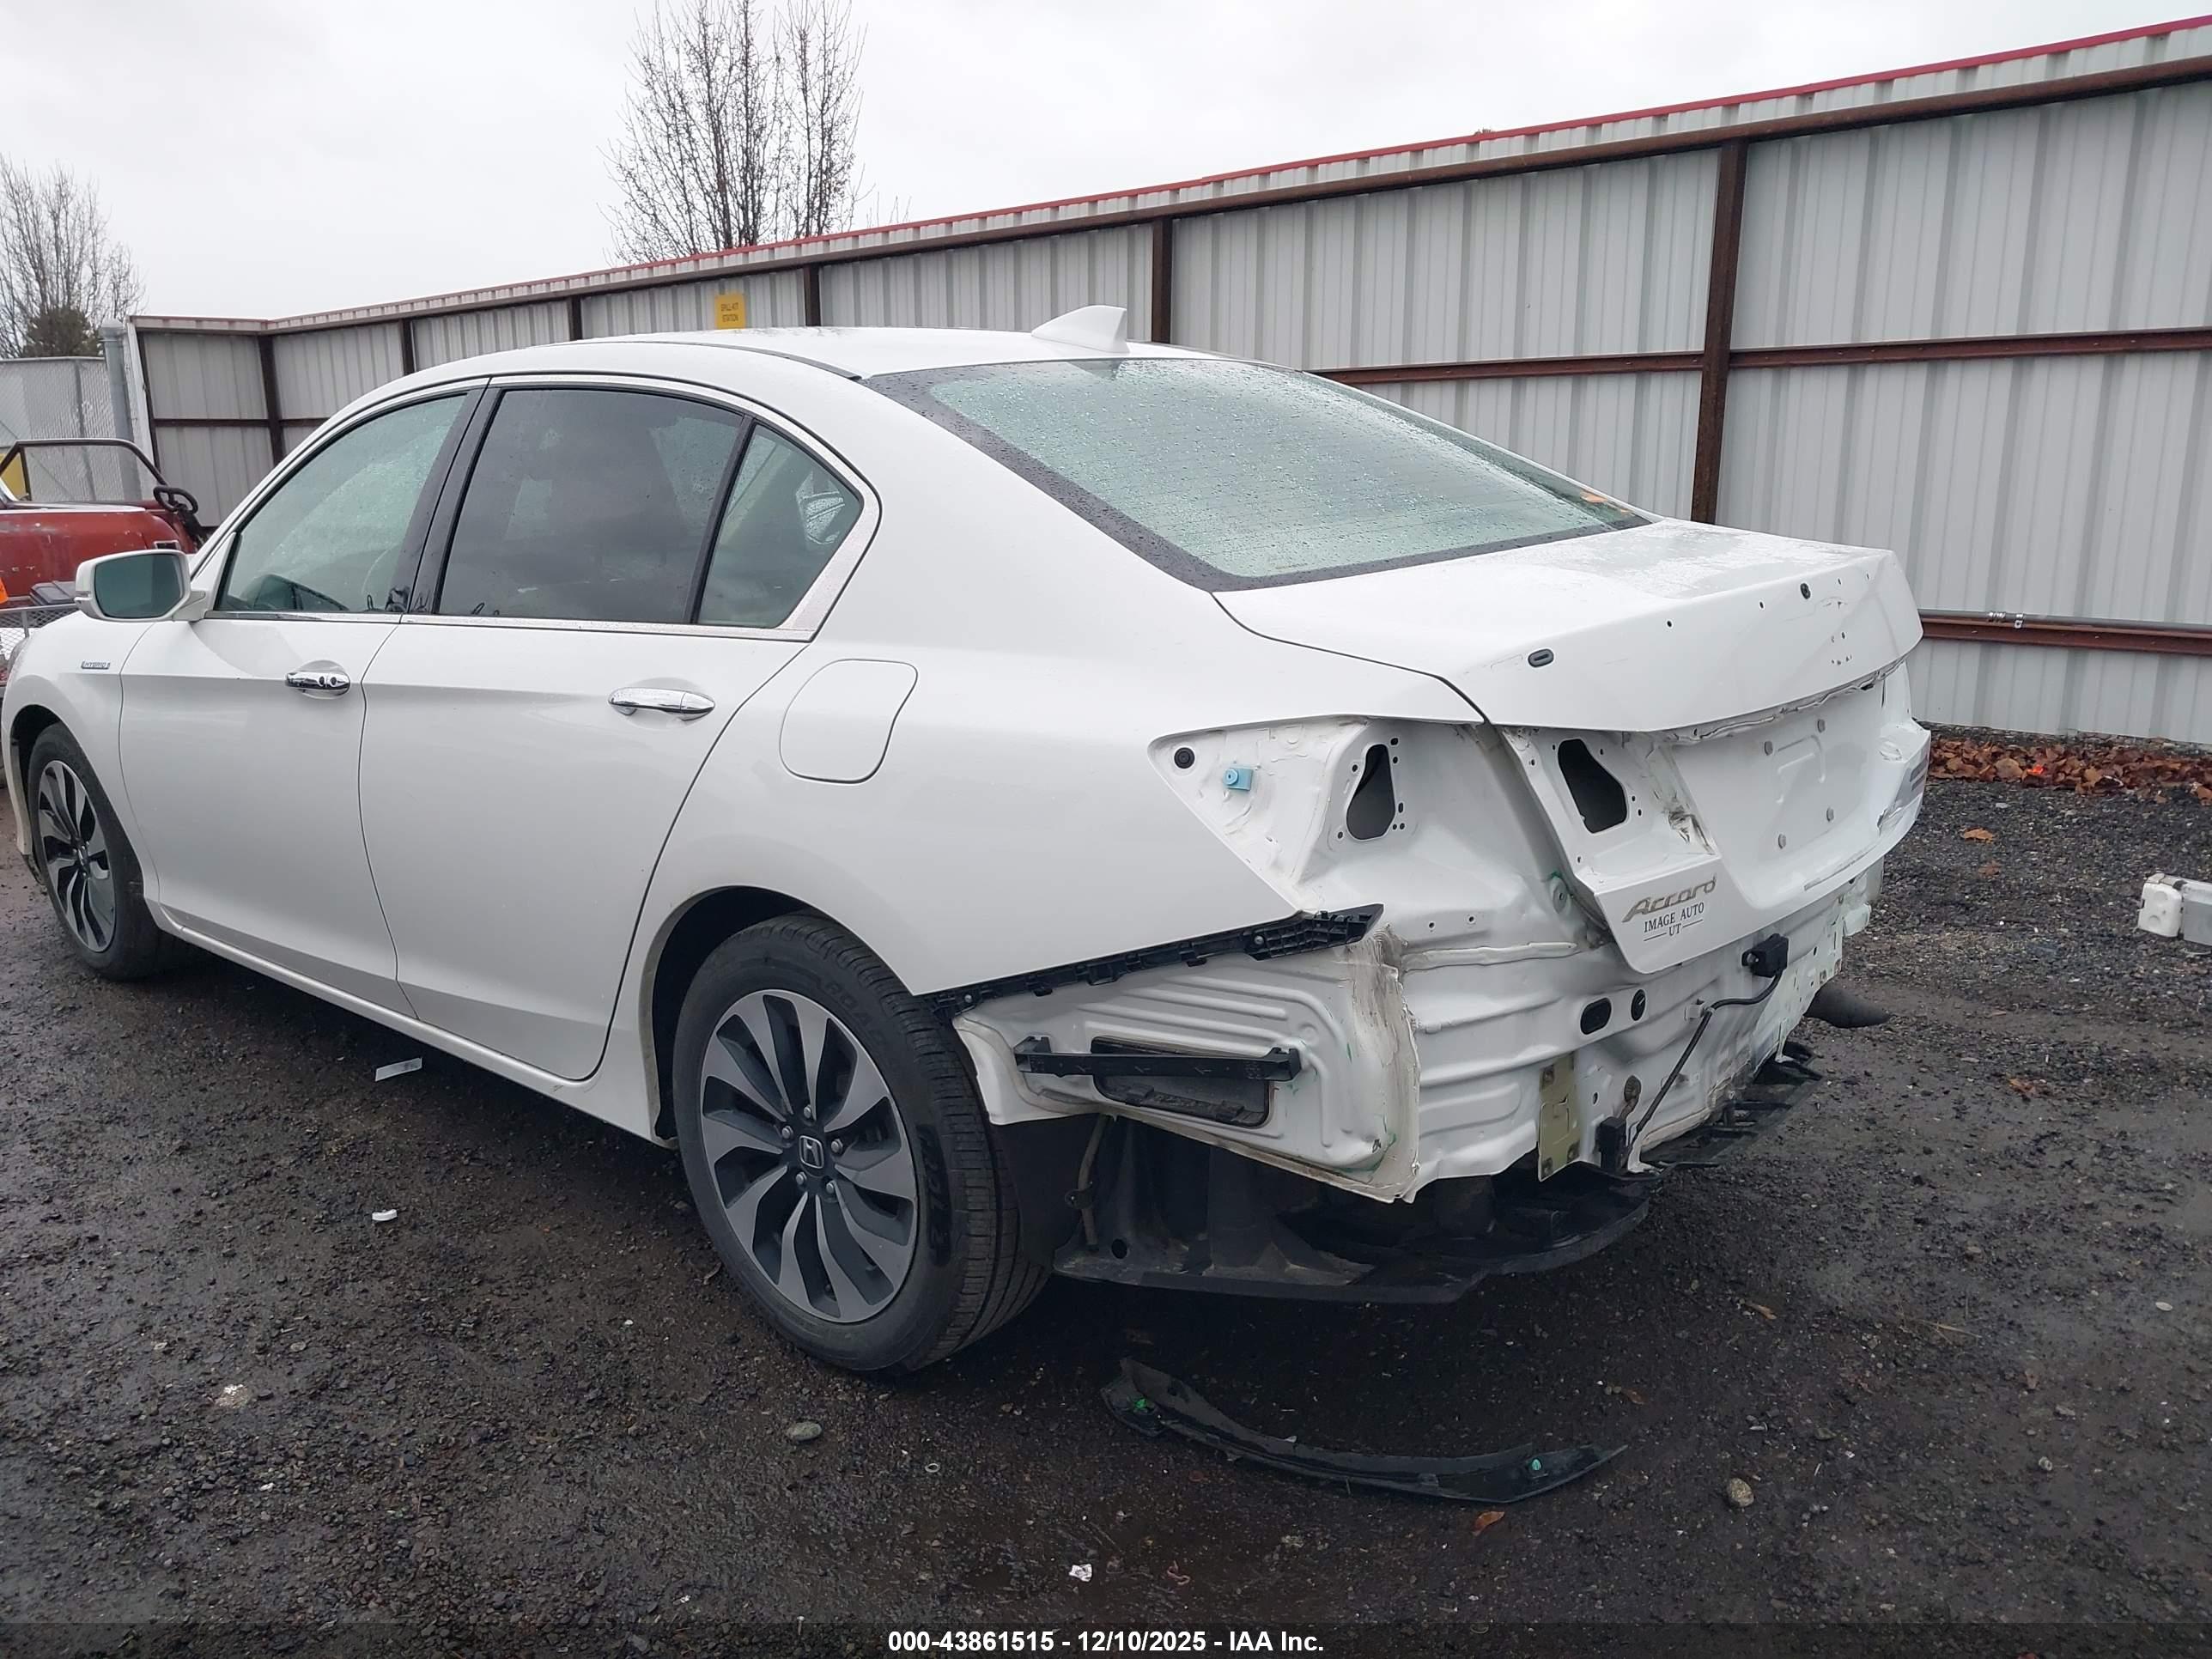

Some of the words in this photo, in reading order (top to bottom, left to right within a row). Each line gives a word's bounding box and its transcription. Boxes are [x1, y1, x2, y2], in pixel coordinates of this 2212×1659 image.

[1621, 872, 1717, 923] Accord
[1644, 912, 1675, 933] IMAGE
[1680, 902, 1705, 922] AUTO
[1668, 922, 1682, 937] UT
